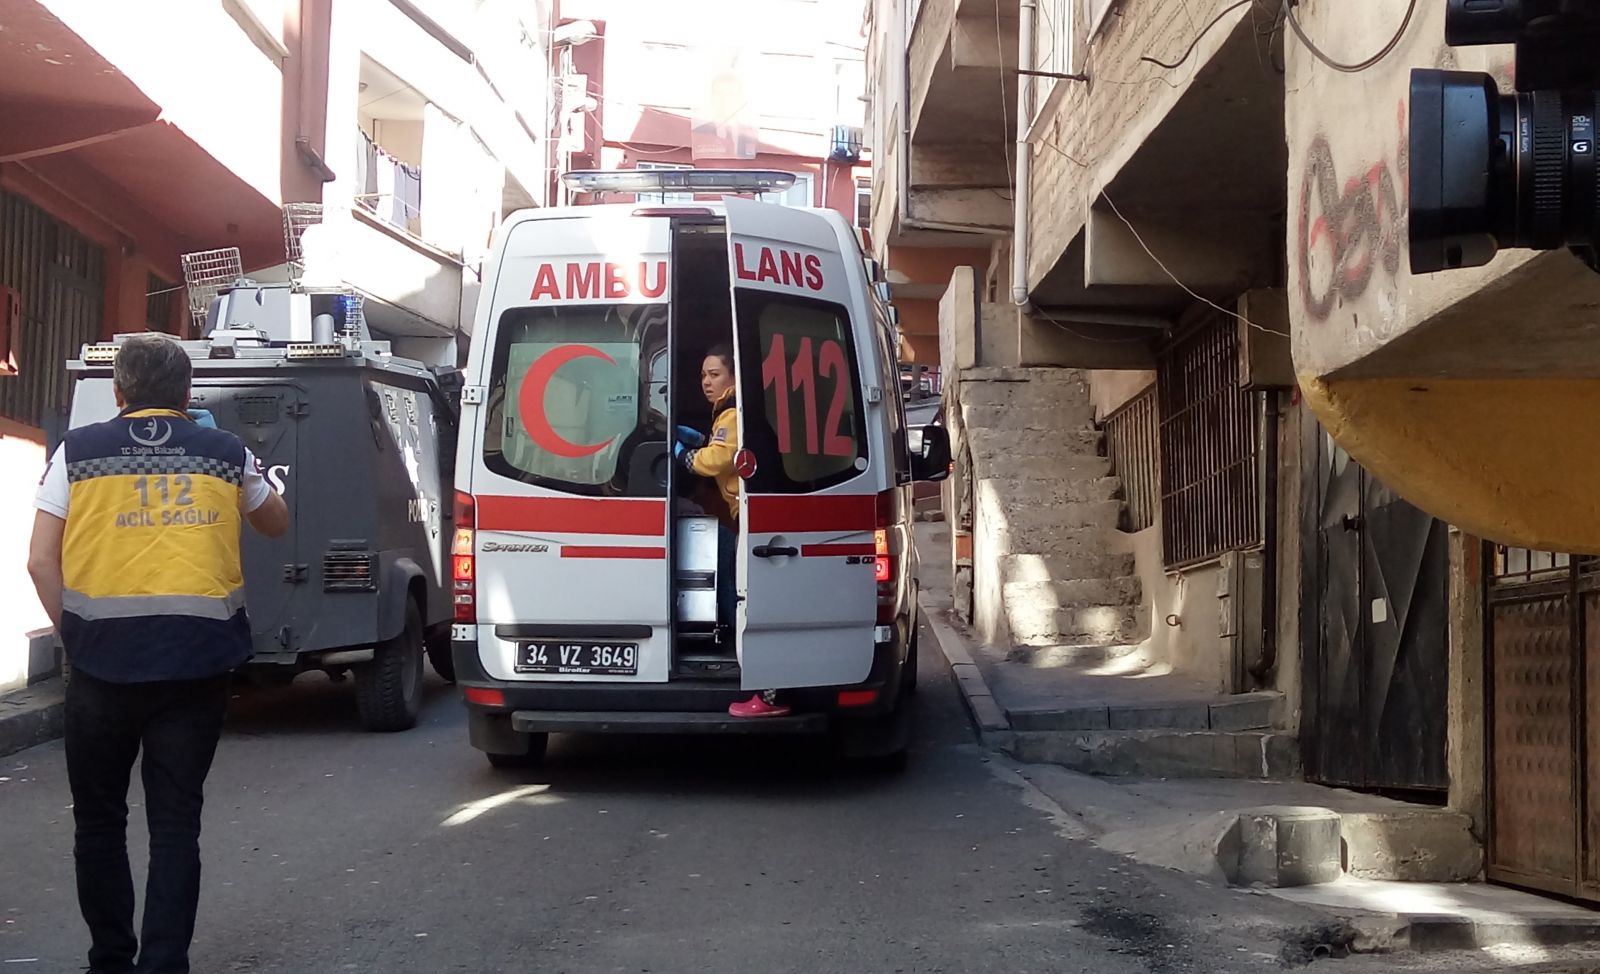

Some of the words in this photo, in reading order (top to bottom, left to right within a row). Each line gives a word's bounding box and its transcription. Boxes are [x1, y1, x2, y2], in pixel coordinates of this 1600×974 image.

[1572, 142, 1588, 152] G
[530, 262, 667, 300] AMBU
[735, 243, 824, 291] LANS
[762, 333, 853, 456] 112
[134, 475, 194, 507] 112
[115, 509, 155, 528] ACİL
[527, 645, 548, 665] 34
[560, 646, 581, 666] VZ
[591, 646, 634, 667] 3649
